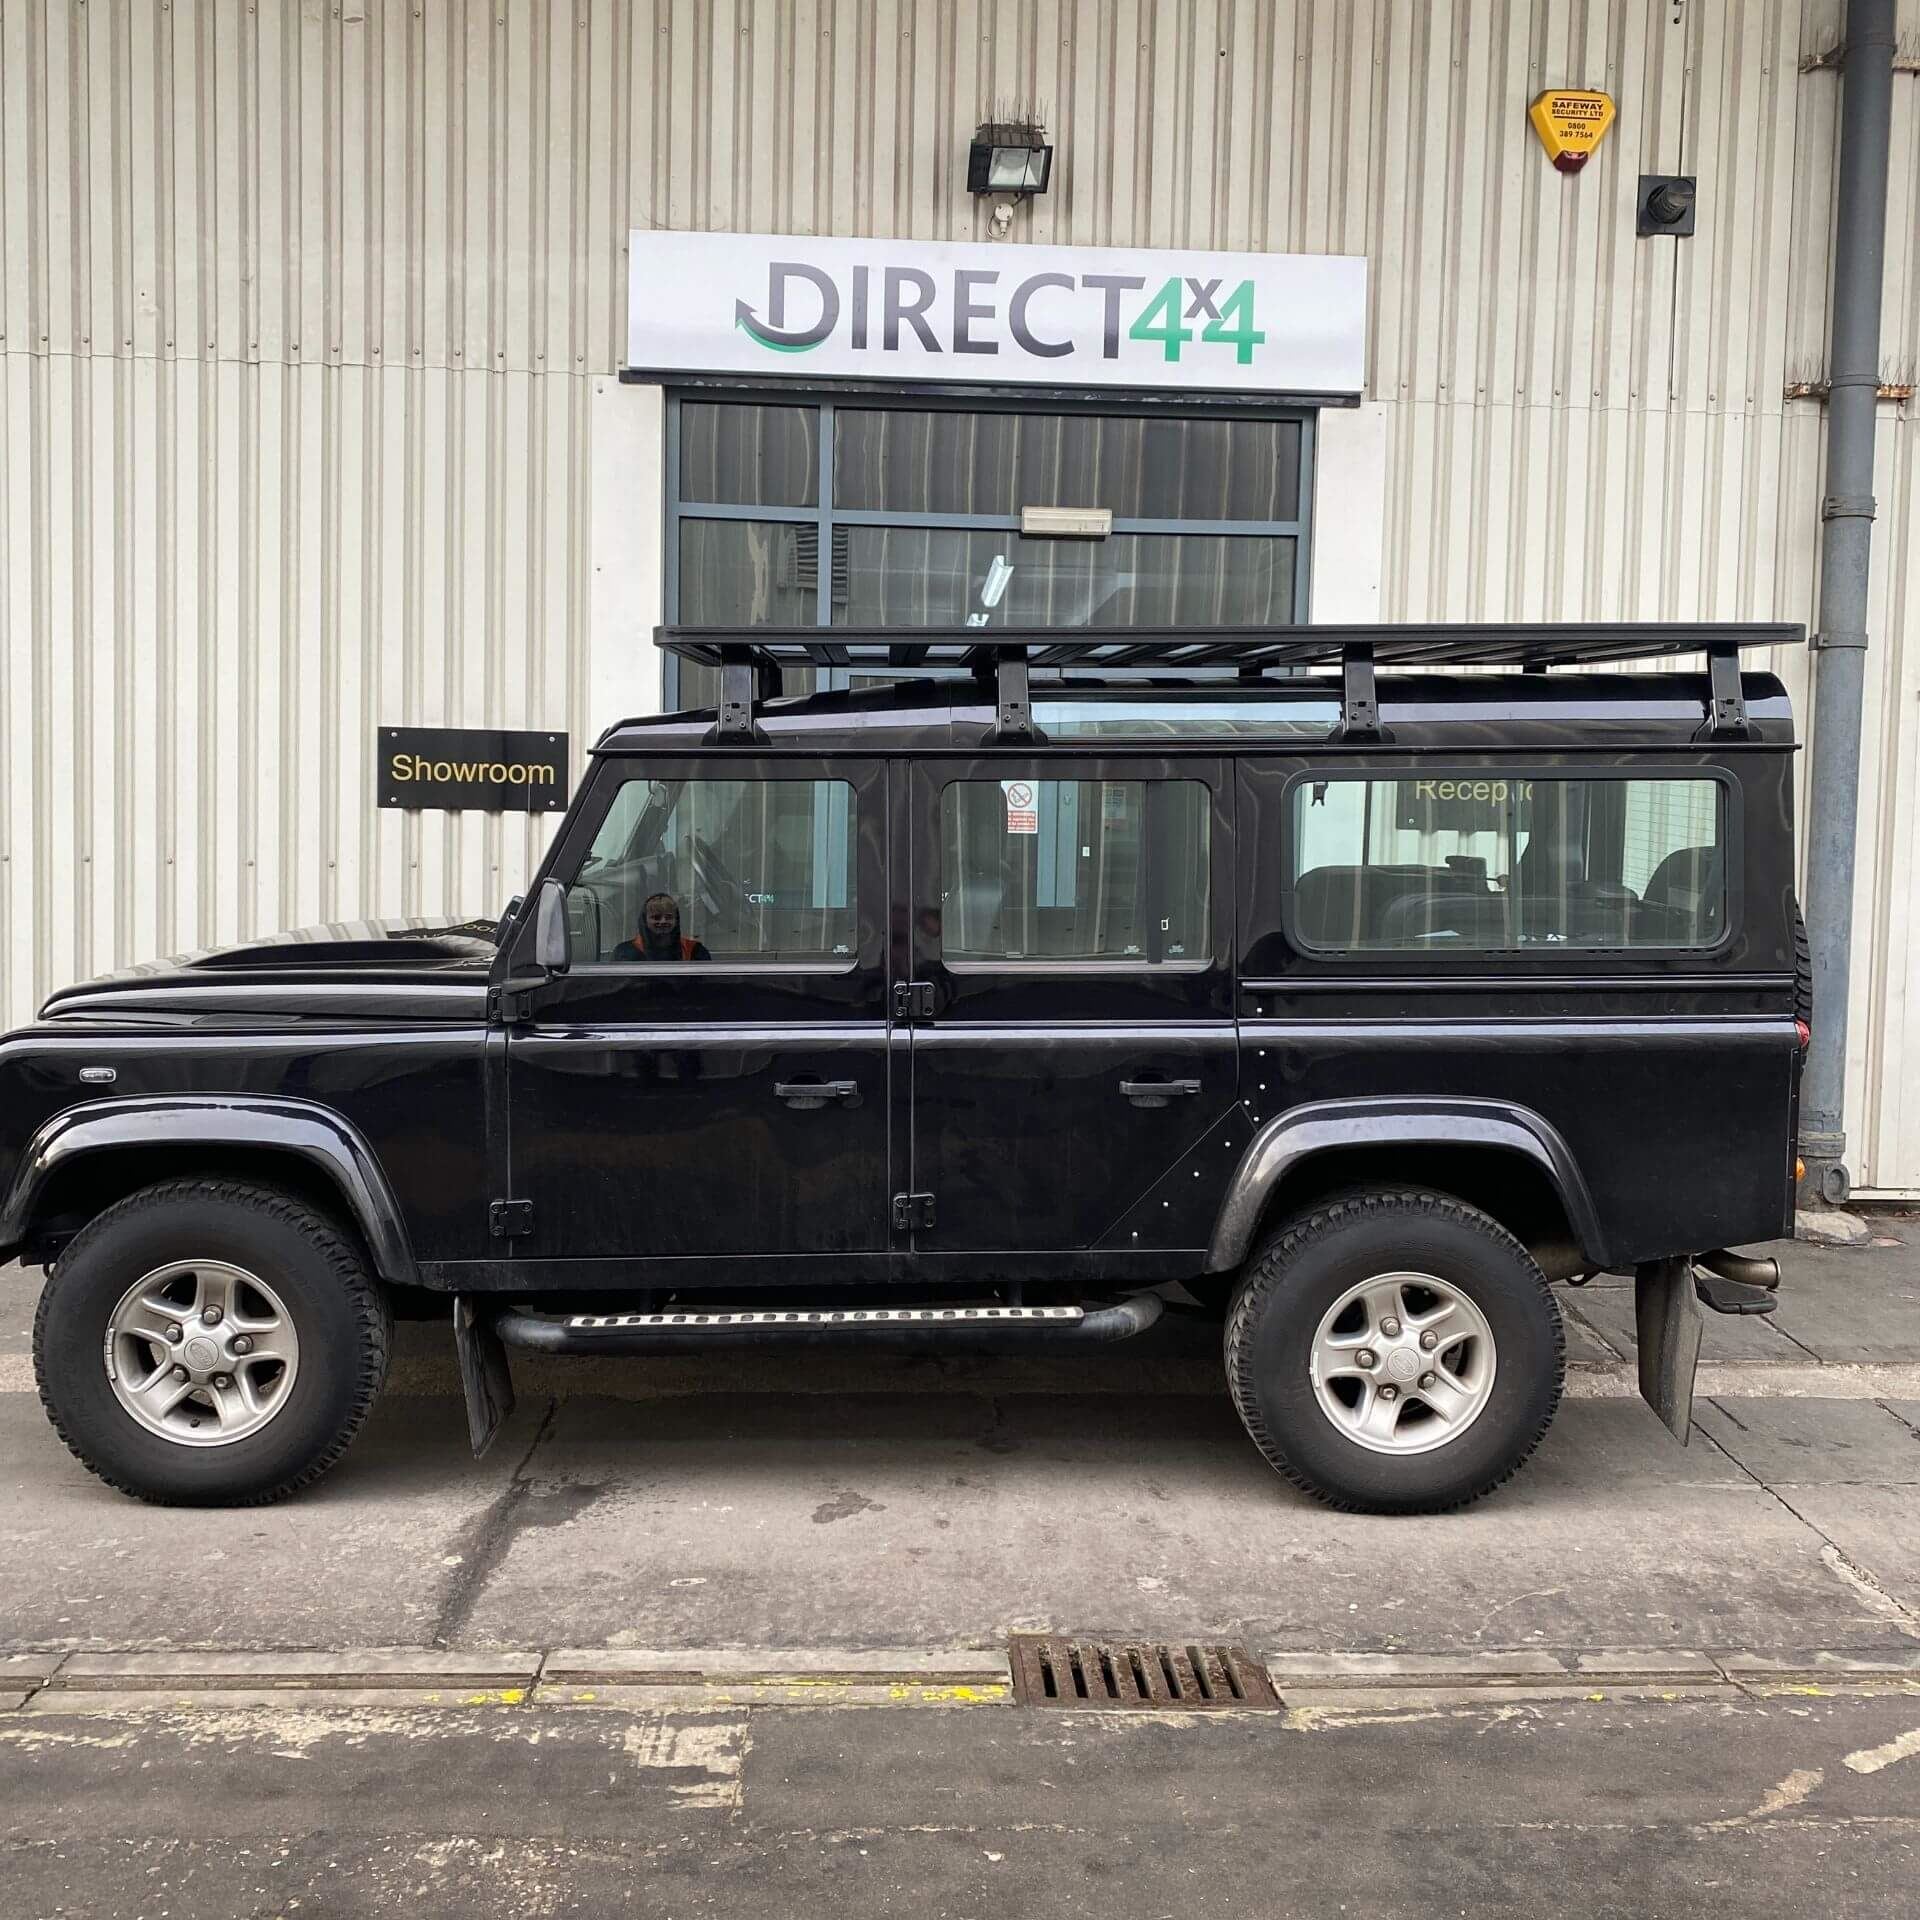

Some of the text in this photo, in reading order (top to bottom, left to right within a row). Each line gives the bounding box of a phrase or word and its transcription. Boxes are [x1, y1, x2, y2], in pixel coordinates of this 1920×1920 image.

[1552, 101, 1604, 111] SAFEWAY
[1551, 109, 1588, 117] SECURITY
[1567, 122, 1586, 130] 0800
[1559, 130, 1573, 138] 389
[391, 753, 555, 786] Showroom
